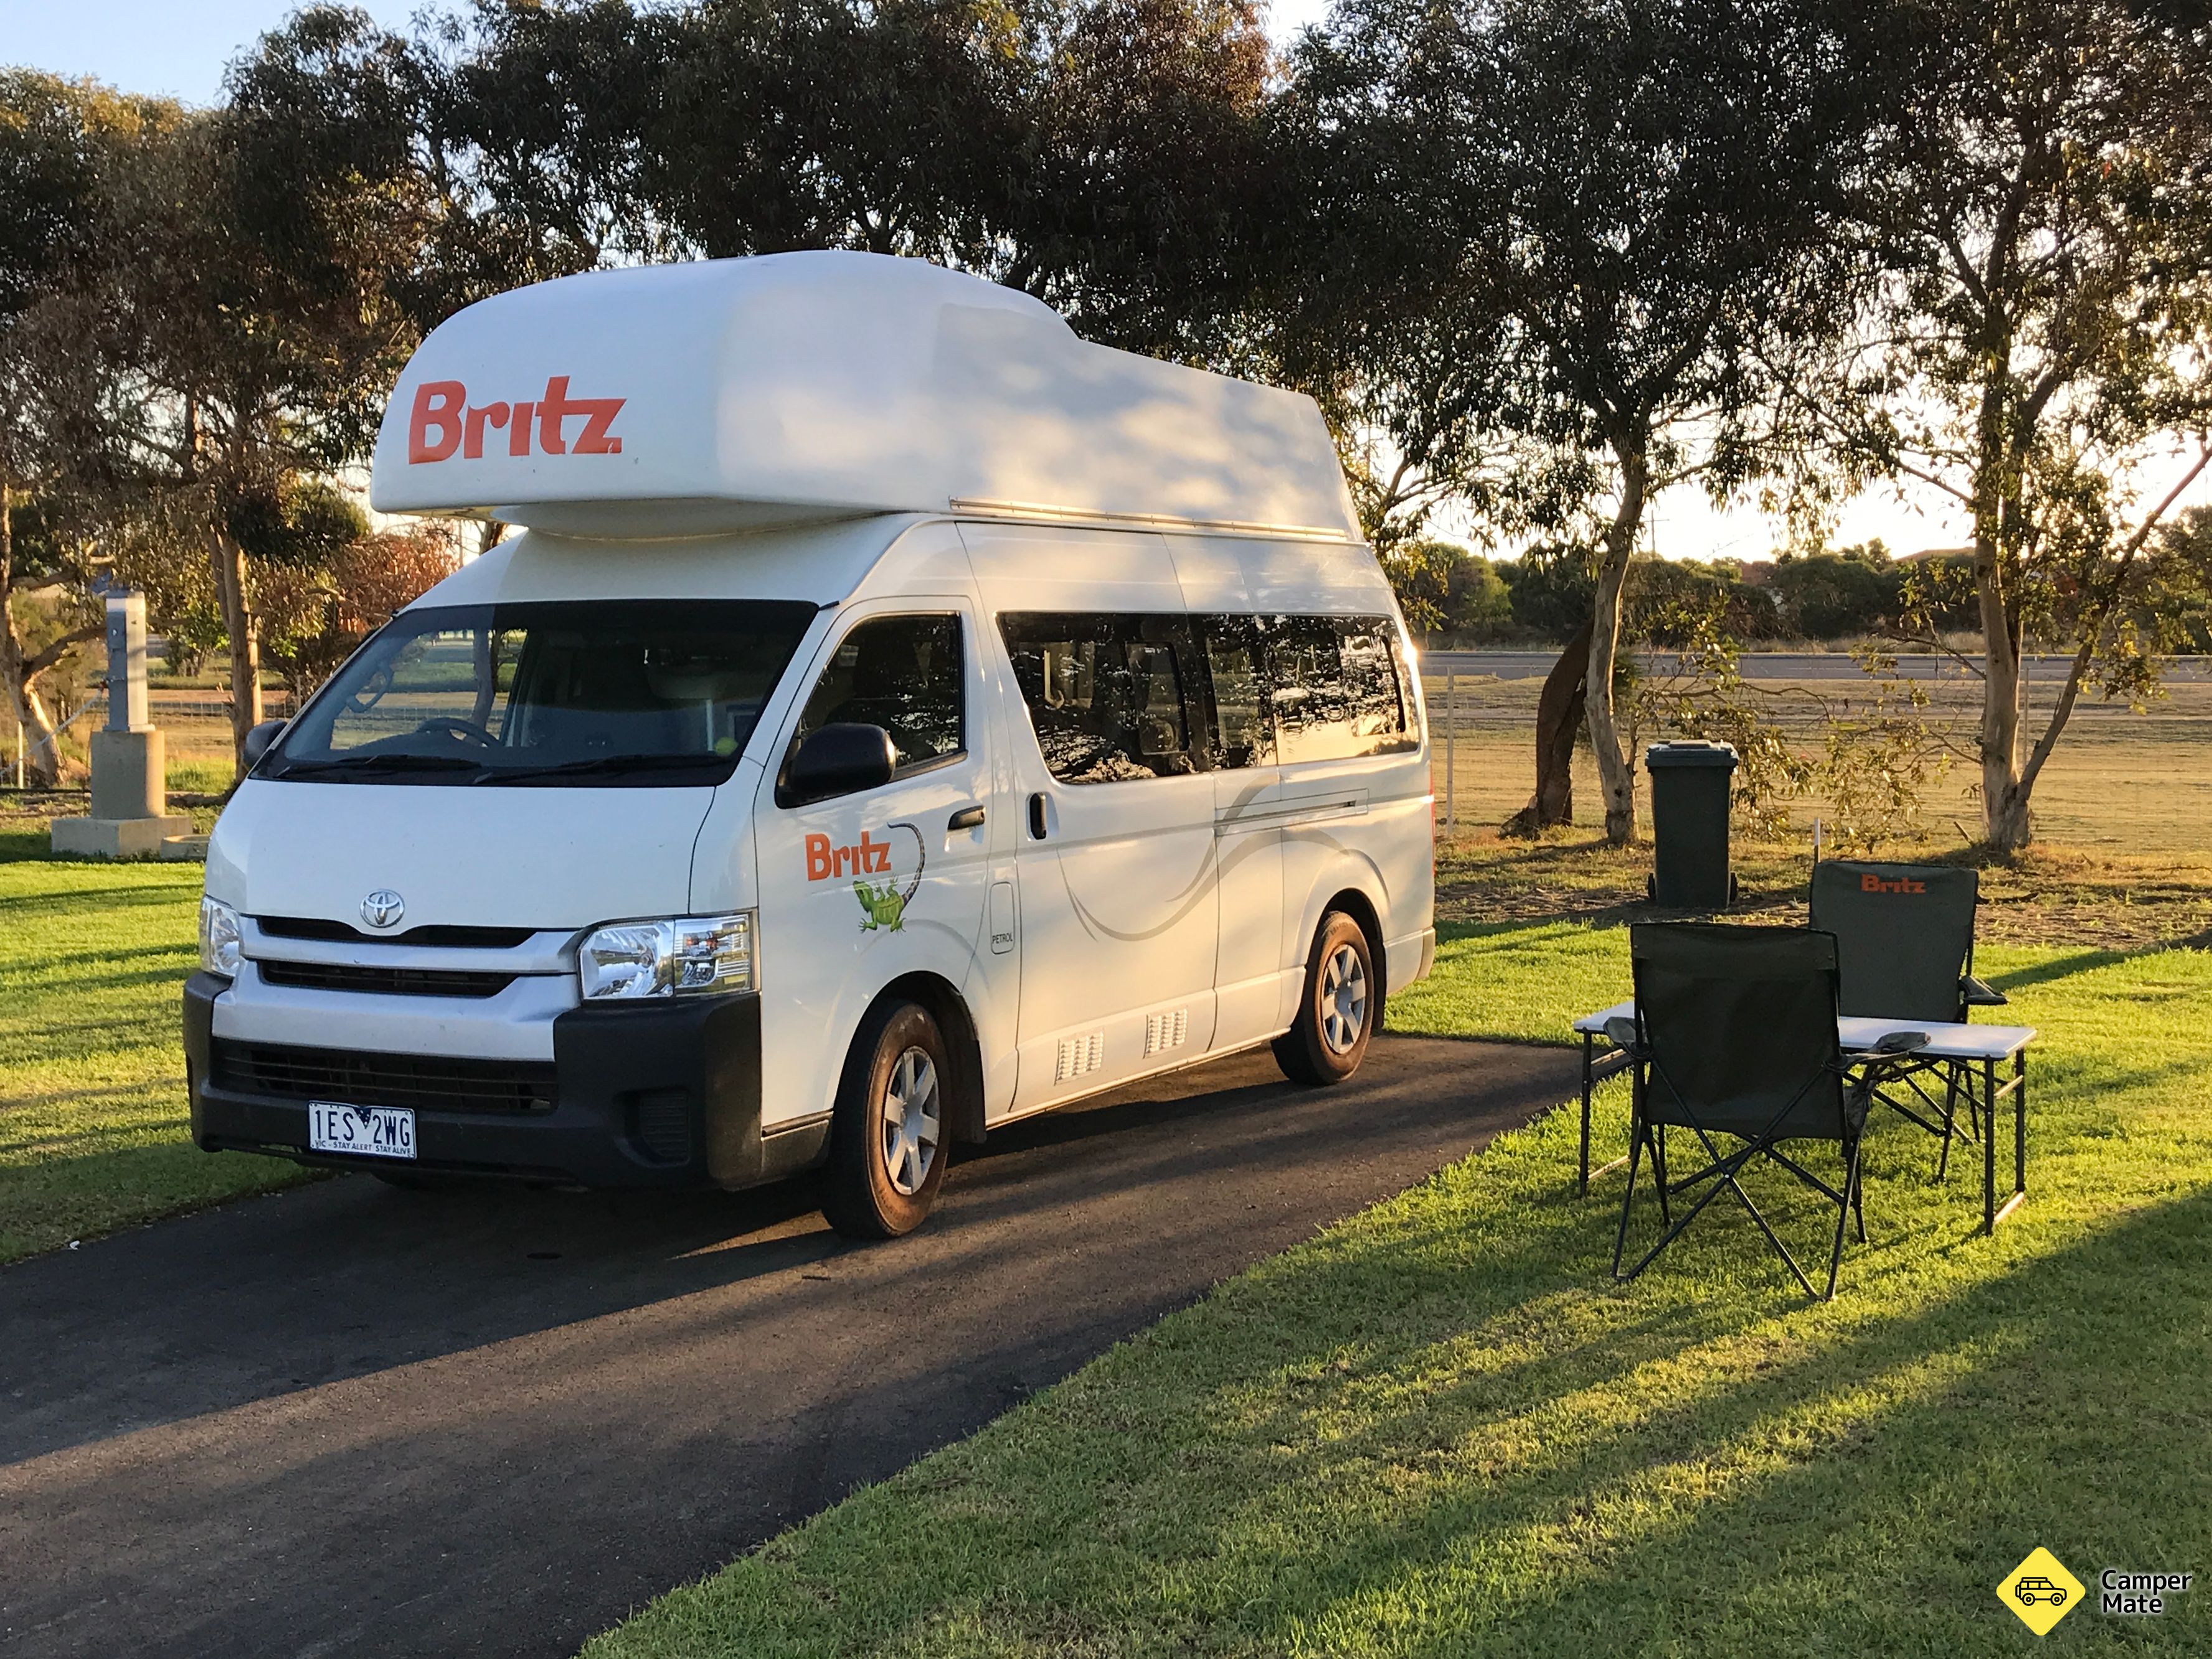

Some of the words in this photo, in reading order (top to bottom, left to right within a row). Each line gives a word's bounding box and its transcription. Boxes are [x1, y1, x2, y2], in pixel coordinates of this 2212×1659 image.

[409, 376, 626, 465] Britz
[805, 831, 891, 881] Britz
[1861, 874, 1926, 894] Britz
[992, 932, 1013, 943] PETROL
[315, 1110, 354, 1141] 1ES
[373, 1115, 410, 1146] 2WG
[333, 1141, 349, 1149] STAY
[351, 1143, 372, 1151] ALERT
[376, 1145, 391, 1153] STAY
[392, 1146, 411, 1155] ALIVE
